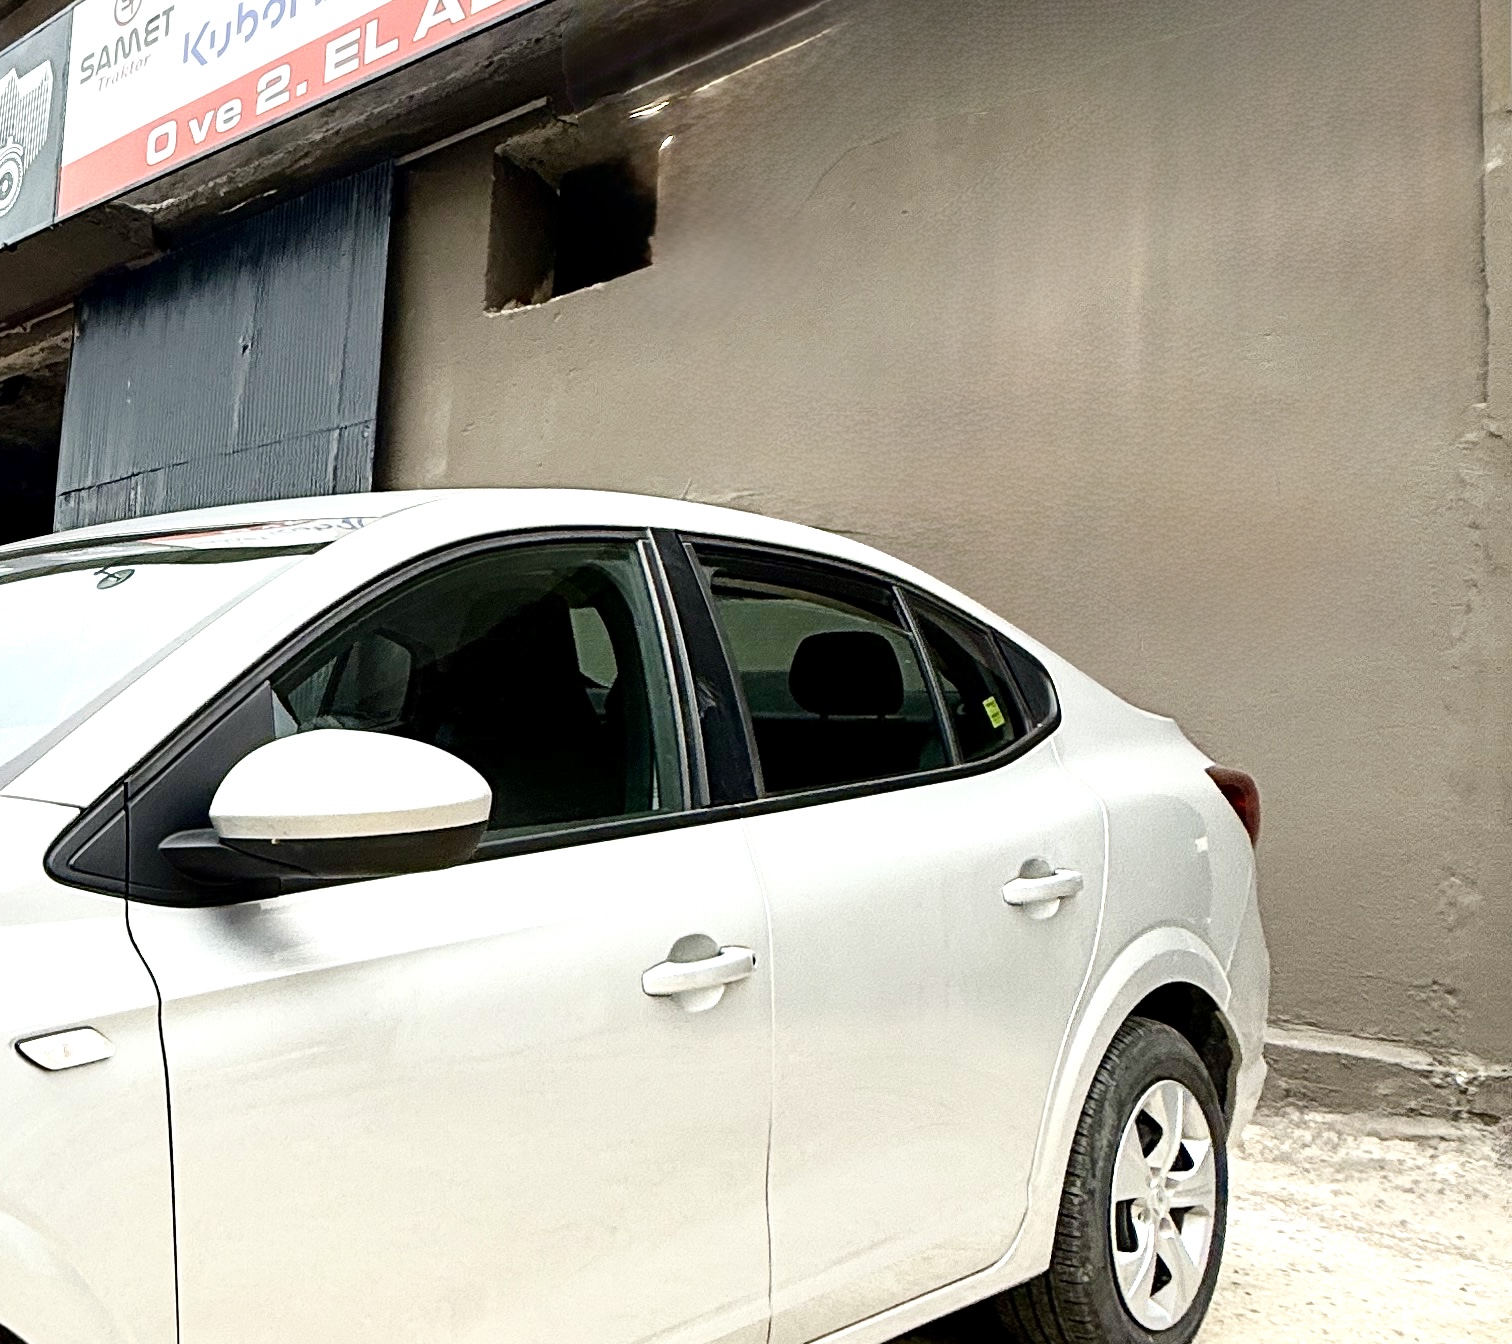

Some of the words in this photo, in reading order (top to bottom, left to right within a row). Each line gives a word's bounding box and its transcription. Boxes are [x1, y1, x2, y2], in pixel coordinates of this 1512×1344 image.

[79, 4, 175, 85] SAMET
[188, 97, 241, 146] ve
[255, 62, 308, 115] 2.
[323, 18, 400, 86] EL
